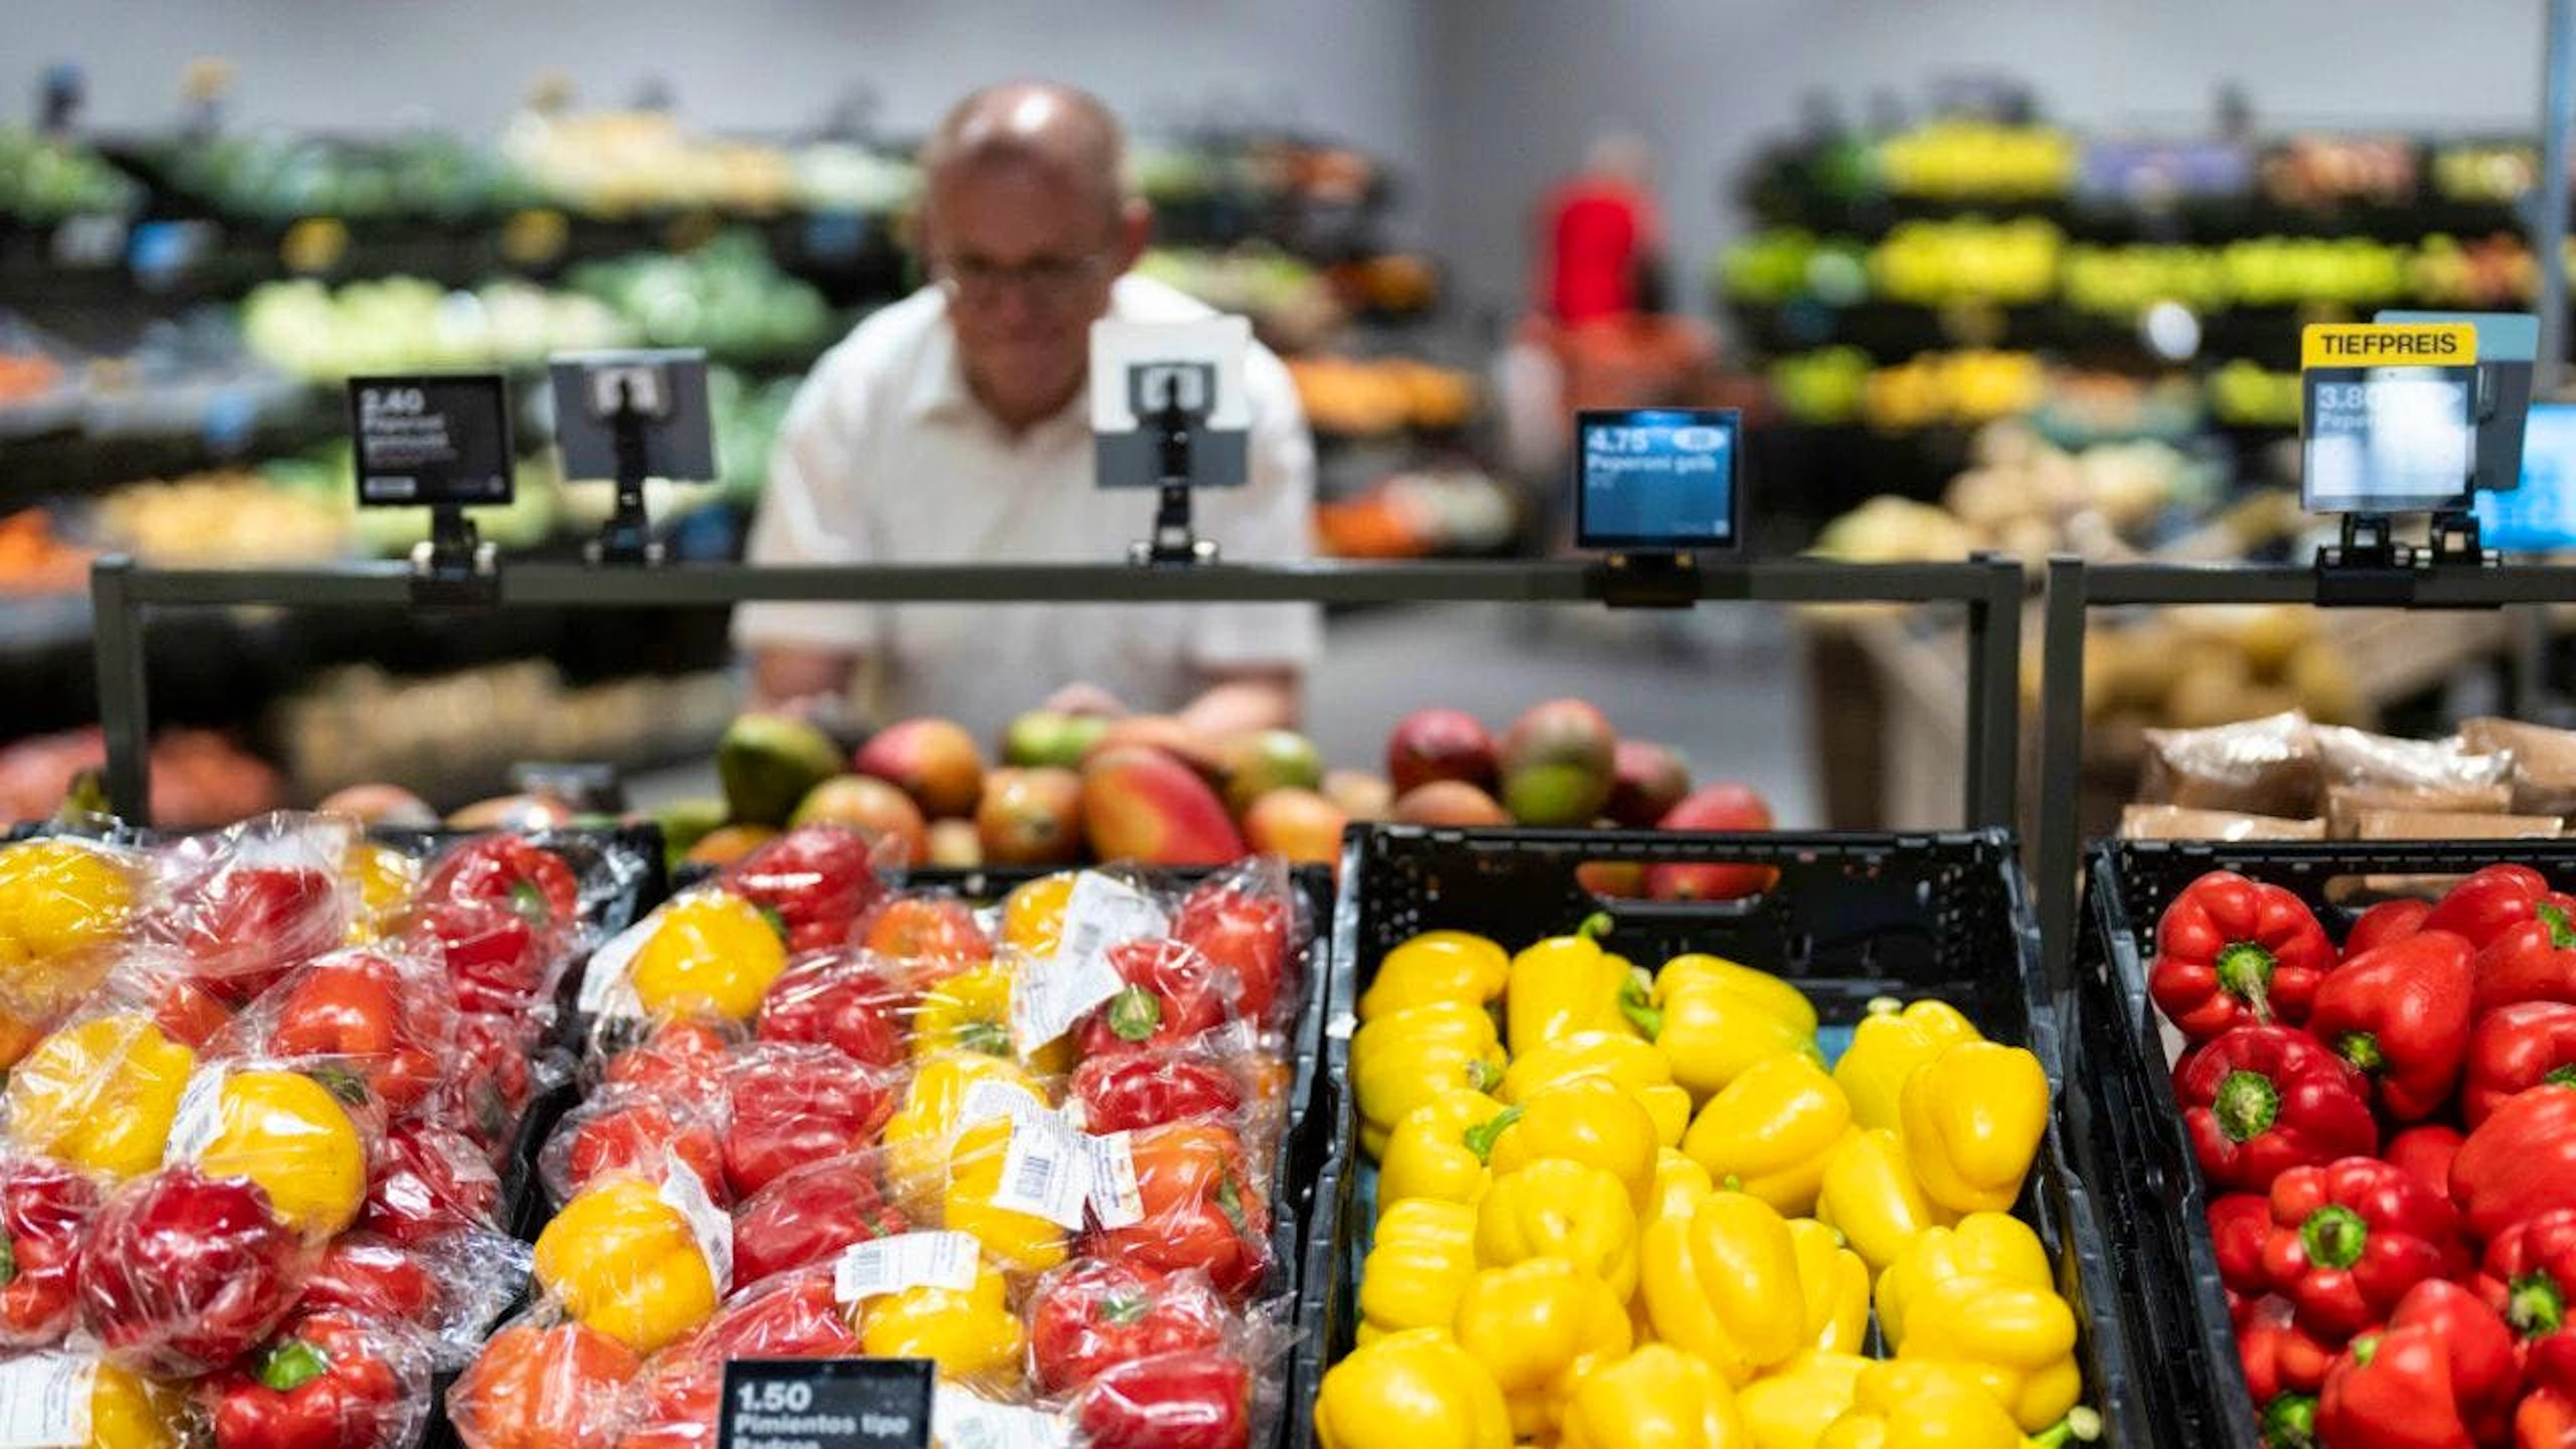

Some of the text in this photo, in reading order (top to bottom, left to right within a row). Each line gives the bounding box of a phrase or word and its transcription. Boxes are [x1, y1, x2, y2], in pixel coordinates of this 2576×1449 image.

[2321, 333, 2457, 354] TIEFPREIS
[1587, 427, 1649, 452] 4.75
[737, 1381, 812, 1412] 1.50
[734, 1412, 911, 1438] Pimientos tipo
